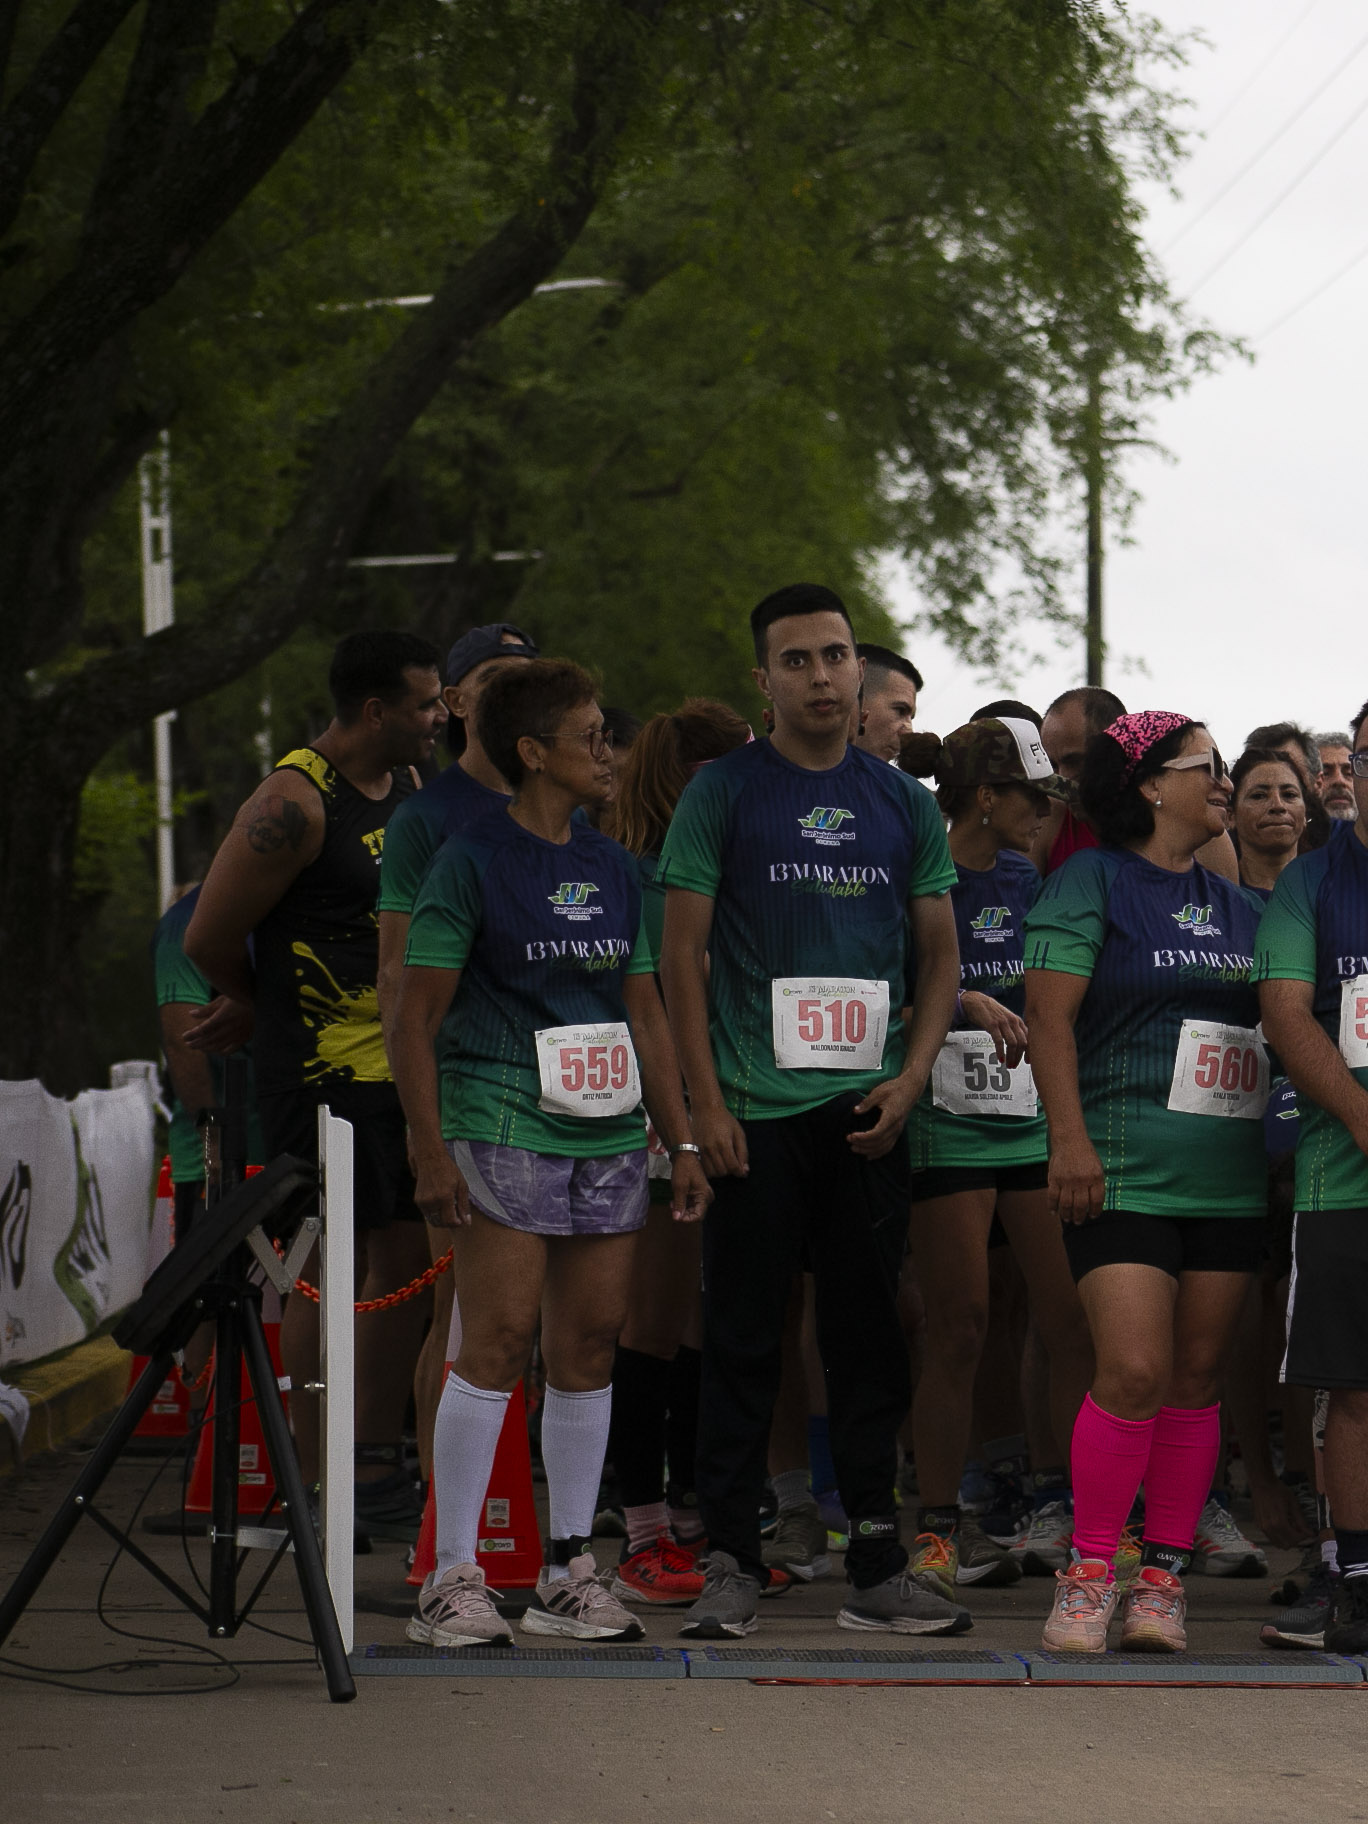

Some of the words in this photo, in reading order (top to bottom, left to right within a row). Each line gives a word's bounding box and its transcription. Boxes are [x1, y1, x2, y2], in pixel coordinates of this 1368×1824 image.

[798, 999, 867, 1044] 510
[559, 1044, 629, 1092] 559
[963, 1052, 1011, 1092] 53
[1194, 1043, 1259, 1092] 560
